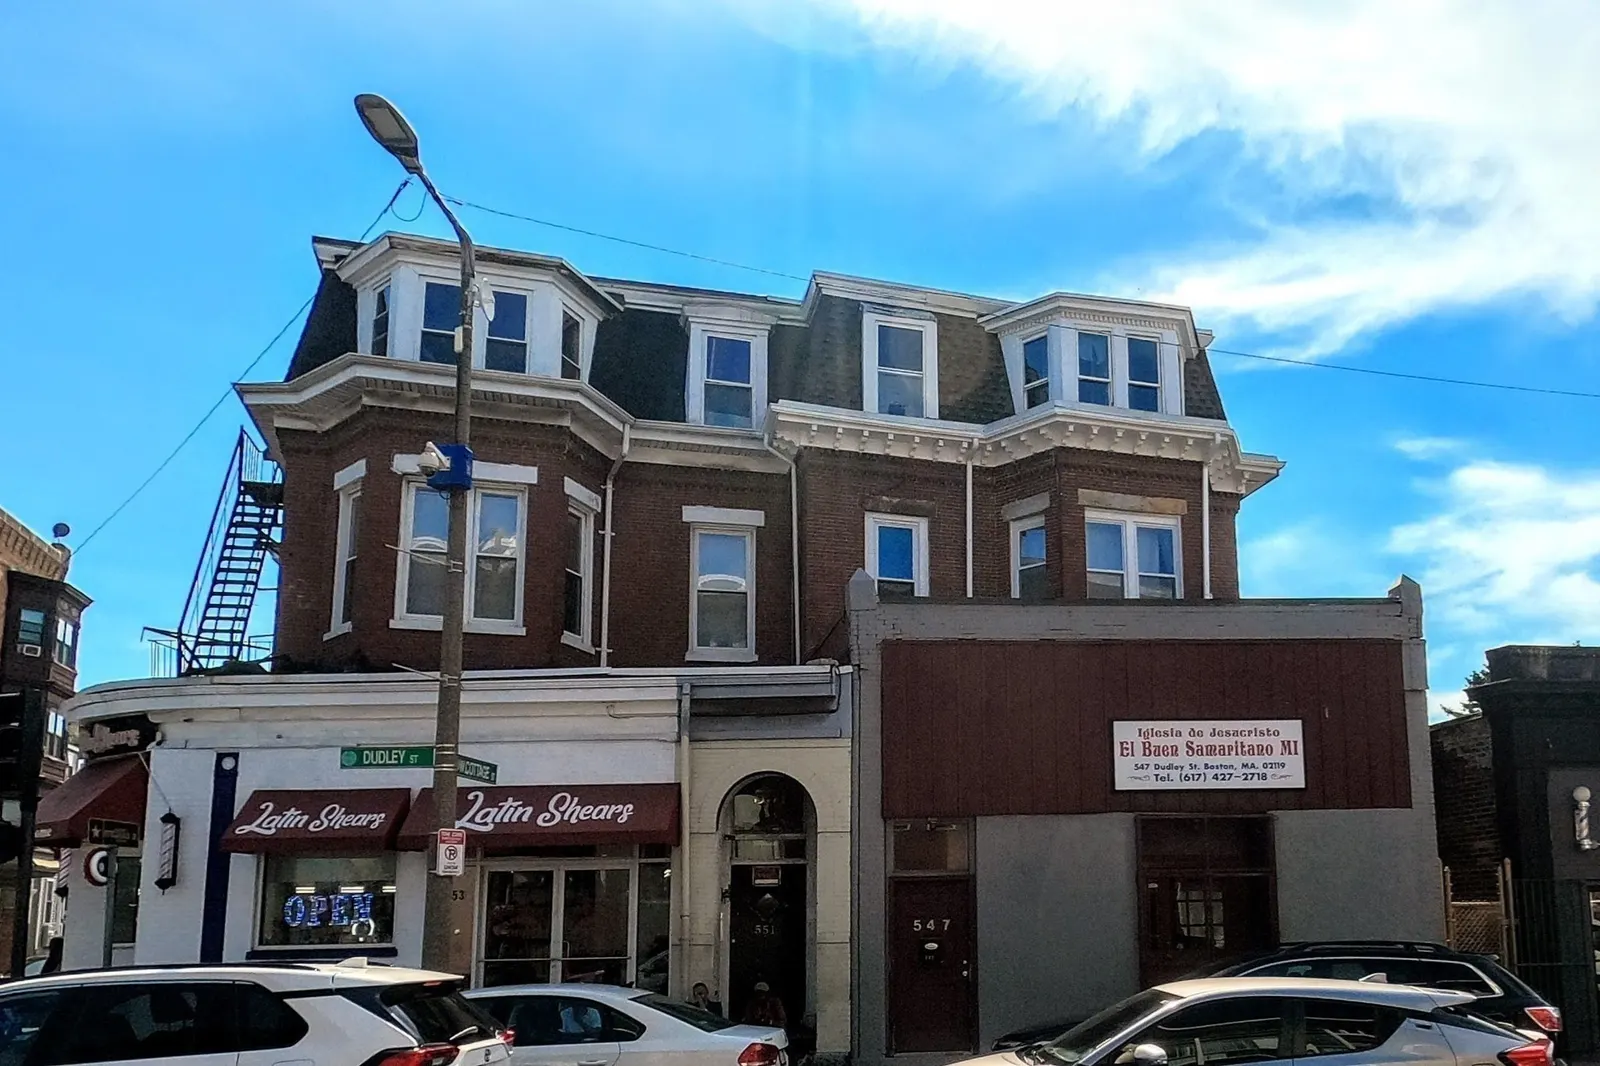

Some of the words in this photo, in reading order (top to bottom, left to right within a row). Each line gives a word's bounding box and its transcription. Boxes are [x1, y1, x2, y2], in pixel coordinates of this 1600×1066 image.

[1137, 728, 1182, 740] Iglesia
[1188, 728, 1204, 737] de
[1209, 727, 1280, 738] Jesucristo
[1119, 741, 1135, 757] El
[1141, 741, 1179, 757] Buen
[1185, 740, 1274, 757] Samaritano
[1280, 740, 1299, 756] MI
[362, 750, 406, 765] DUDLEY
[409, 755, 419, 764] ST
[1133, 763, 1150, 771] 547
[1154, 763, 1184, 771] Dudley
[1204, 763, 1237, 771] Boston,
[1241, 762, 1259, 770] MA.
[1262, 762, 1286, 770] 02119
[1153, 773, 1174, 782] Tel.
[1180, 772, 1207, 782] (617)
[1212, 772, 1268, 781] 427-2718
[235, 801, 310, 835] Latin
[308, 803, 386, 832] Shears
[455, 791, 533, 832] Latin
[536, 792, 634, 827] Shears
[283, 893, 374, 927] OPEN
[754, 924, 775, 935] 551
[913, 919, 951, 932] 547
